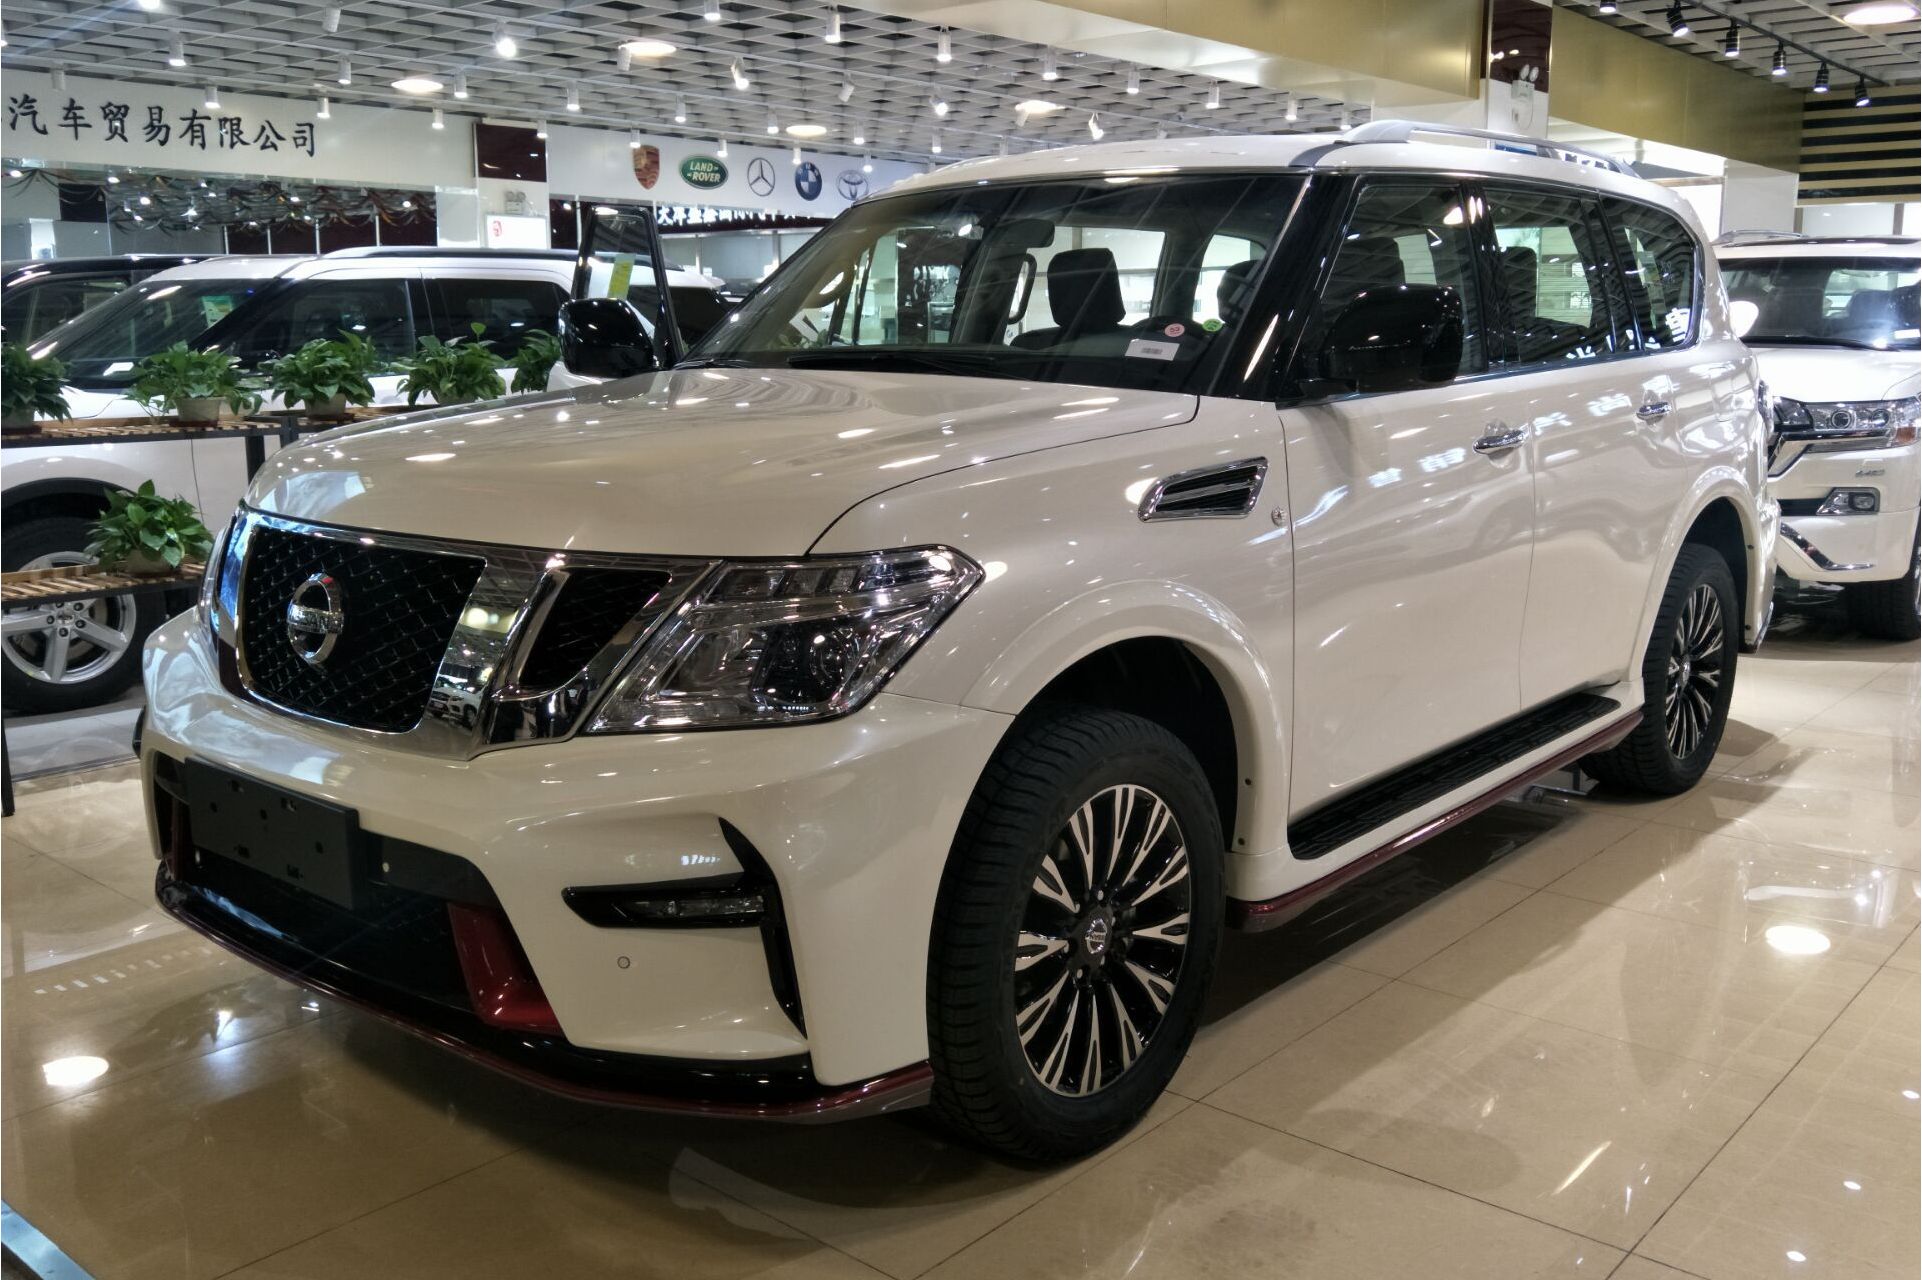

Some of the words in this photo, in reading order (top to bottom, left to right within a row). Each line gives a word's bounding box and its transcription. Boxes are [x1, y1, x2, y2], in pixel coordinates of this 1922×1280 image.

[8, 93, 316, 157] 汽车贸易有限公司
